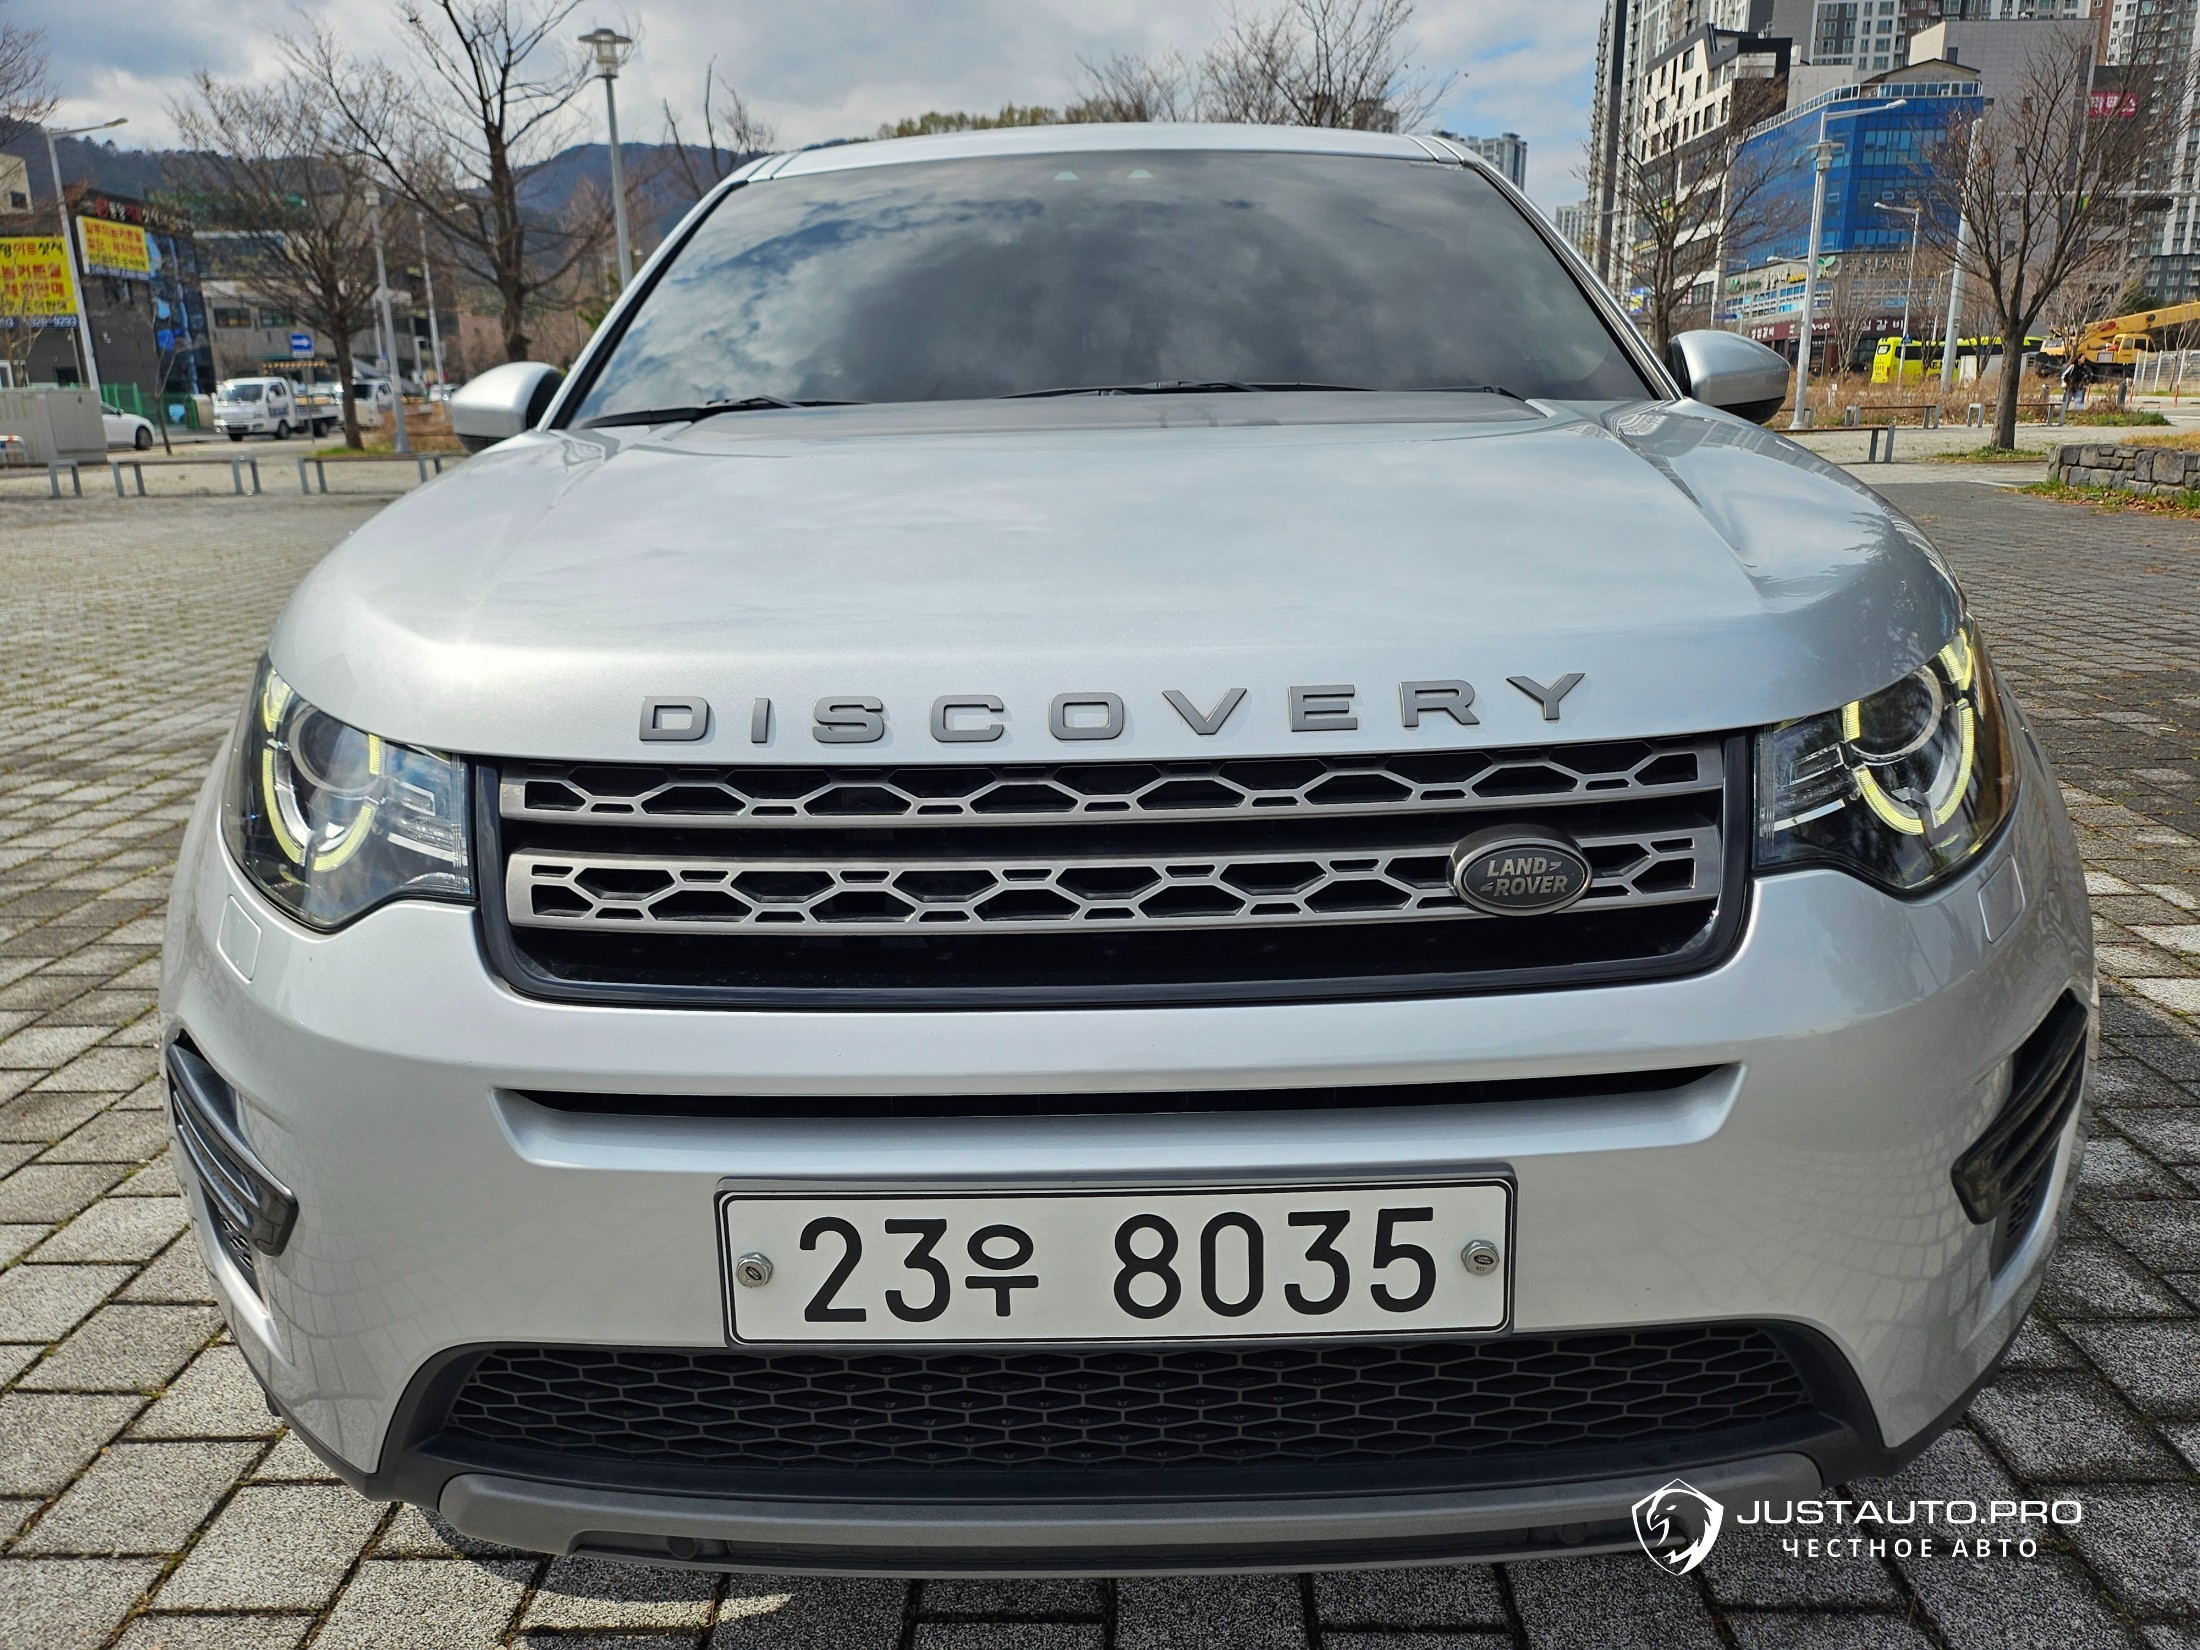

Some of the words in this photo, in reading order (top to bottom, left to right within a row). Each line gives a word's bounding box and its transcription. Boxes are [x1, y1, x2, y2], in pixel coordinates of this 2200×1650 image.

[639, 672, 1585, 743] DISCOVERY
[1487, 858, 1547, 877] LAND
[1493, 875, 1568, 896] ROVER
[799, 1215, 1039, 1323] 23우
[1113, 1206, 1437, 1320] 8035
